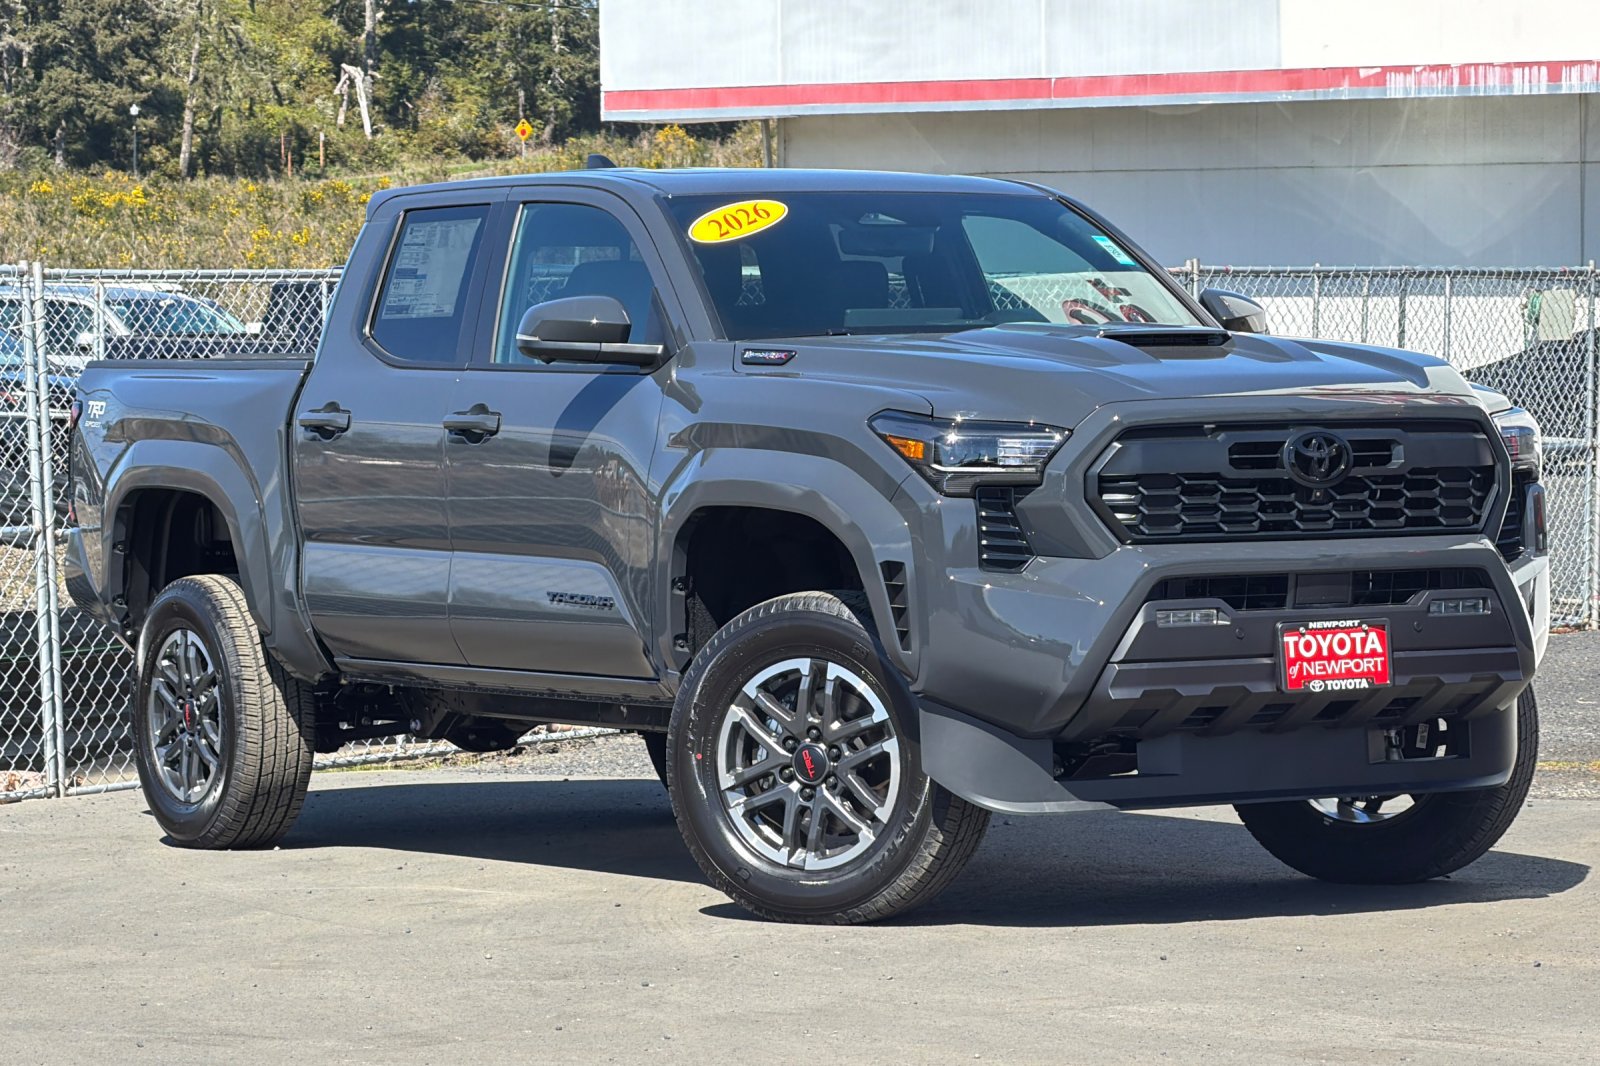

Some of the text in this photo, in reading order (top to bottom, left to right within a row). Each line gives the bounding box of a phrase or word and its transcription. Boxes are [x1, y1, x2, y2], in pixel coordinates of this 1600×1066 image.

[707, 203, 770, 237] 2026
[88, 400, 106, 418] TRD
[546, 591, 614, 608] TACOMA
[1309, 620, 1360, 629] NEWPORT
[1284, 632, 1383, 658] TOYOTA
[1289, 657, 1384, 679] of NEWPORT
[1325, 678, 1369, 690] TOYOTA
[802, 750, 815, 778] TRD
